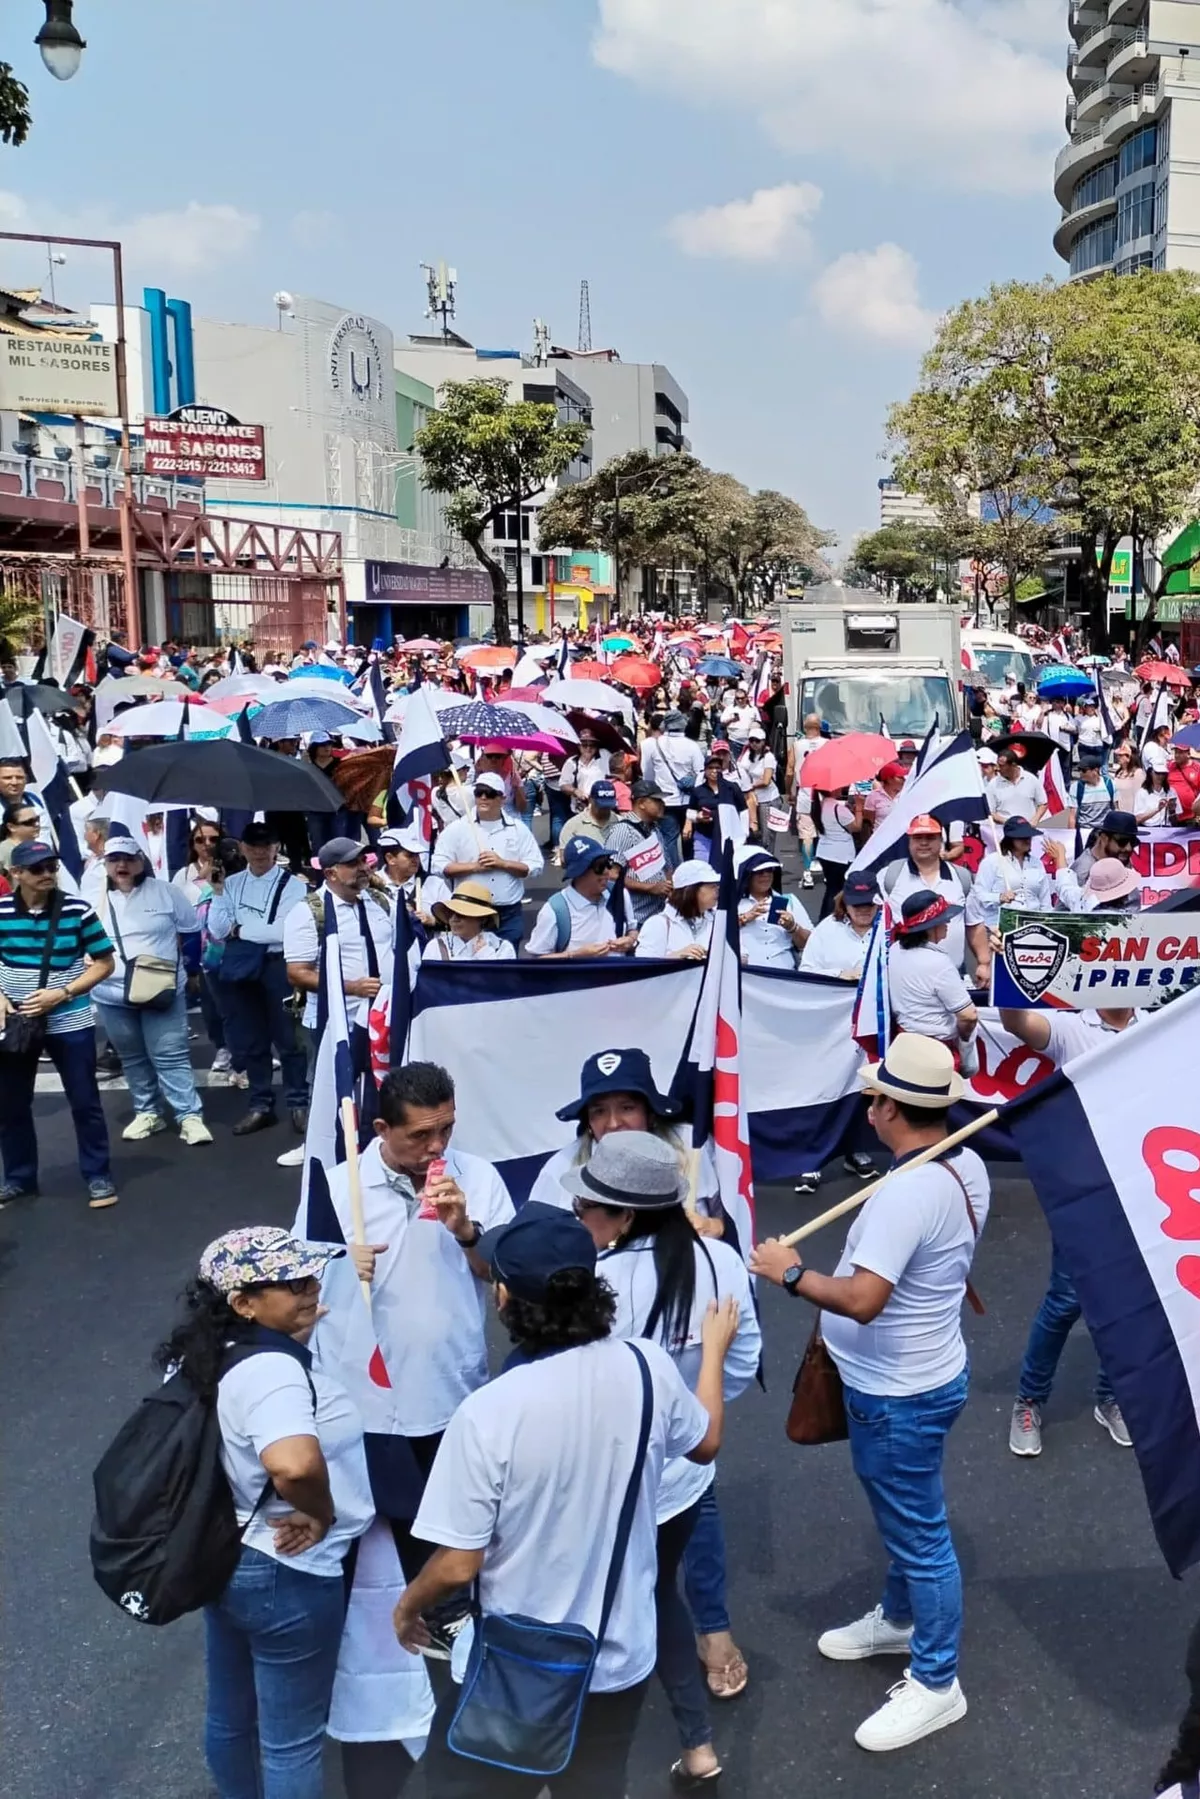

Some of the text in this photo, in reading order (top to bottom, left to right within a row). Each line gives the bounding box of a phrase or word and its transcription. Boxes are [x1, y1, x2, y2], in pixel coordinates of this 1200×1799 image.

[7, 338, 111, 357] RESTAURANTE
[8, 355, 110, 372] MIL SABORES
[18, 395, 60, 404] Servicio
[179, 408, 228, 425] NUEVO
[148, 420, 256, 438] RESTAURANTE
[144, 438, 263, 460] MIL SABORES
[152, 457, 201, 472] 2222-2915
[207, 460, 256, 475] 2221-3412
[1018, 952, 1052, 964] ande
[1079, 937, 1150, 963] SAN
